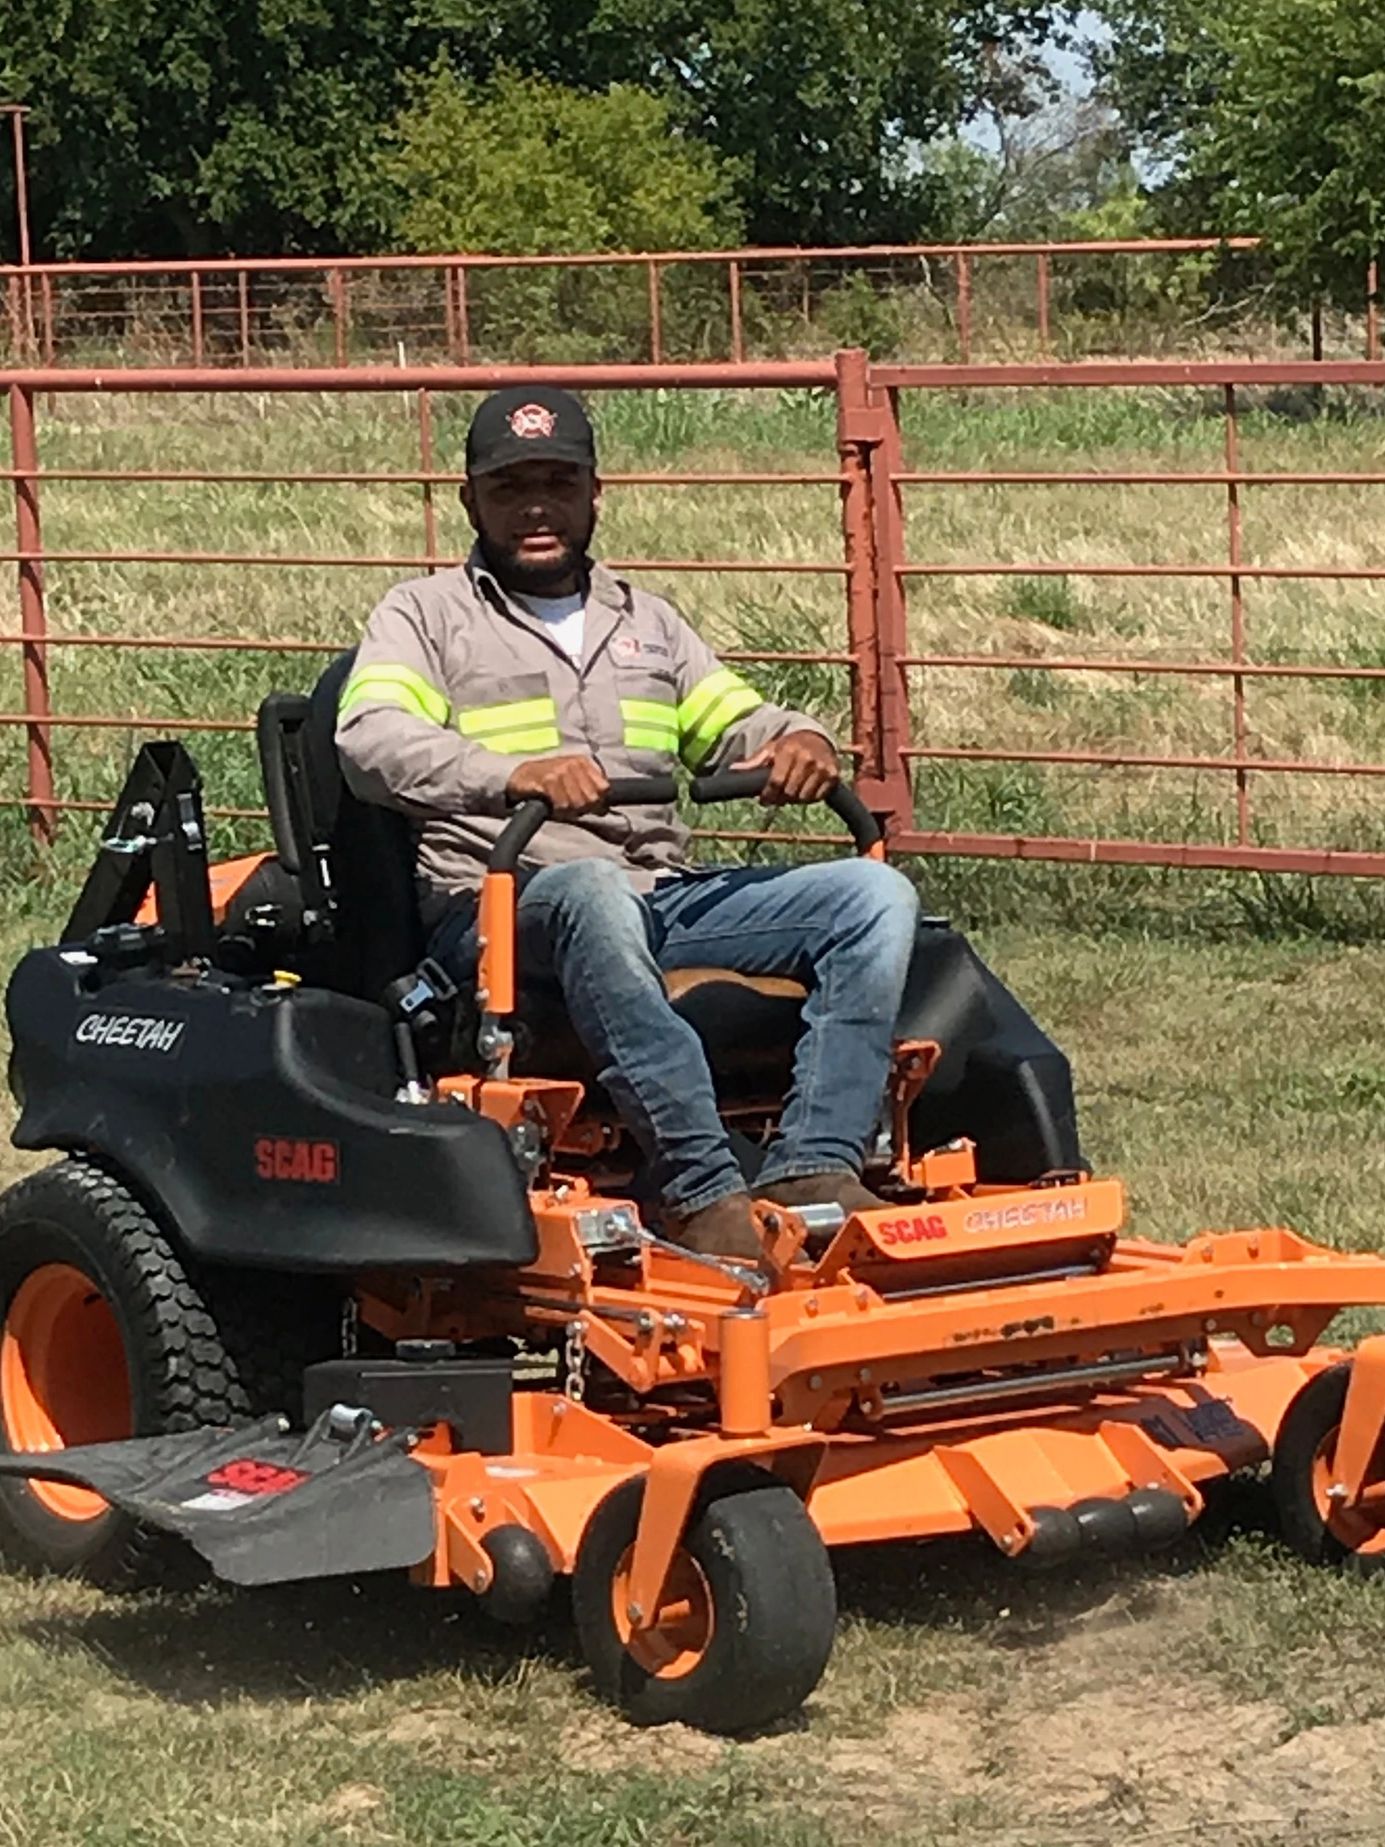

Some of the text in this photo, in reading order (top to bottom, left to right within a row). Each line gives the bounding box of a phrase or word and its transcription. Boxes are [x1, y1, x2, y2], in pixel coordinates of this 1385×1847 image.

[76, 1014, 185, 1051] CHEETAH
[256, 1139, 337, 1181] SCAG
[878, 1198, 1087, 1245] SCAG CHEETAH
